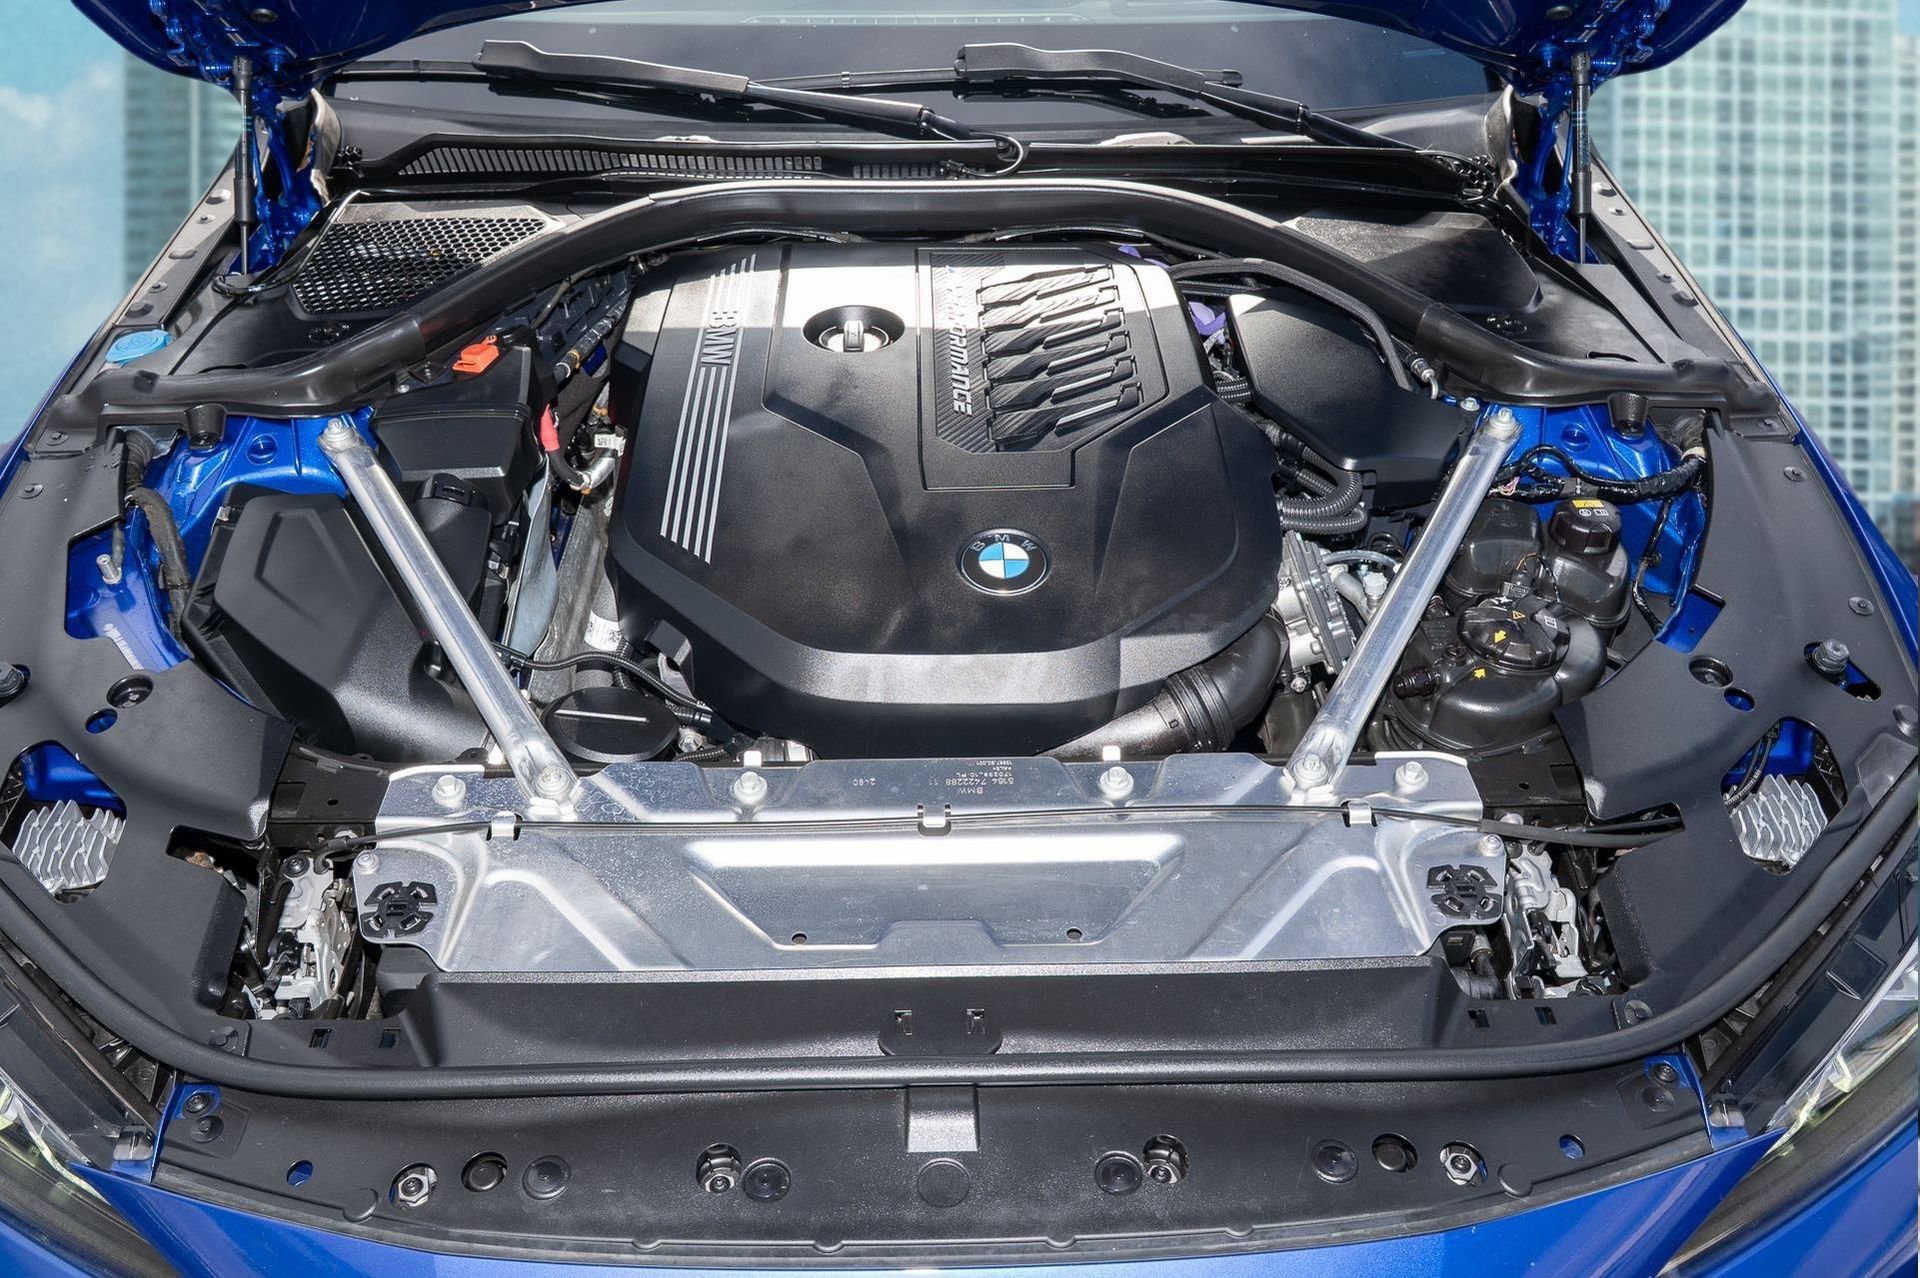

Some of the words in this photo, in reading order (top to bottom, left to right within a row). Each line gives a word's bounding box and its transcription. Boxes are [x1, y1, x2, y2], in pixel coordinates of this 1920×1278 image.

[701, 308, 738, 366] BMW
[948, 289, 972, 416] ORMANCE
[970, 534, 1037, 552] BMW
